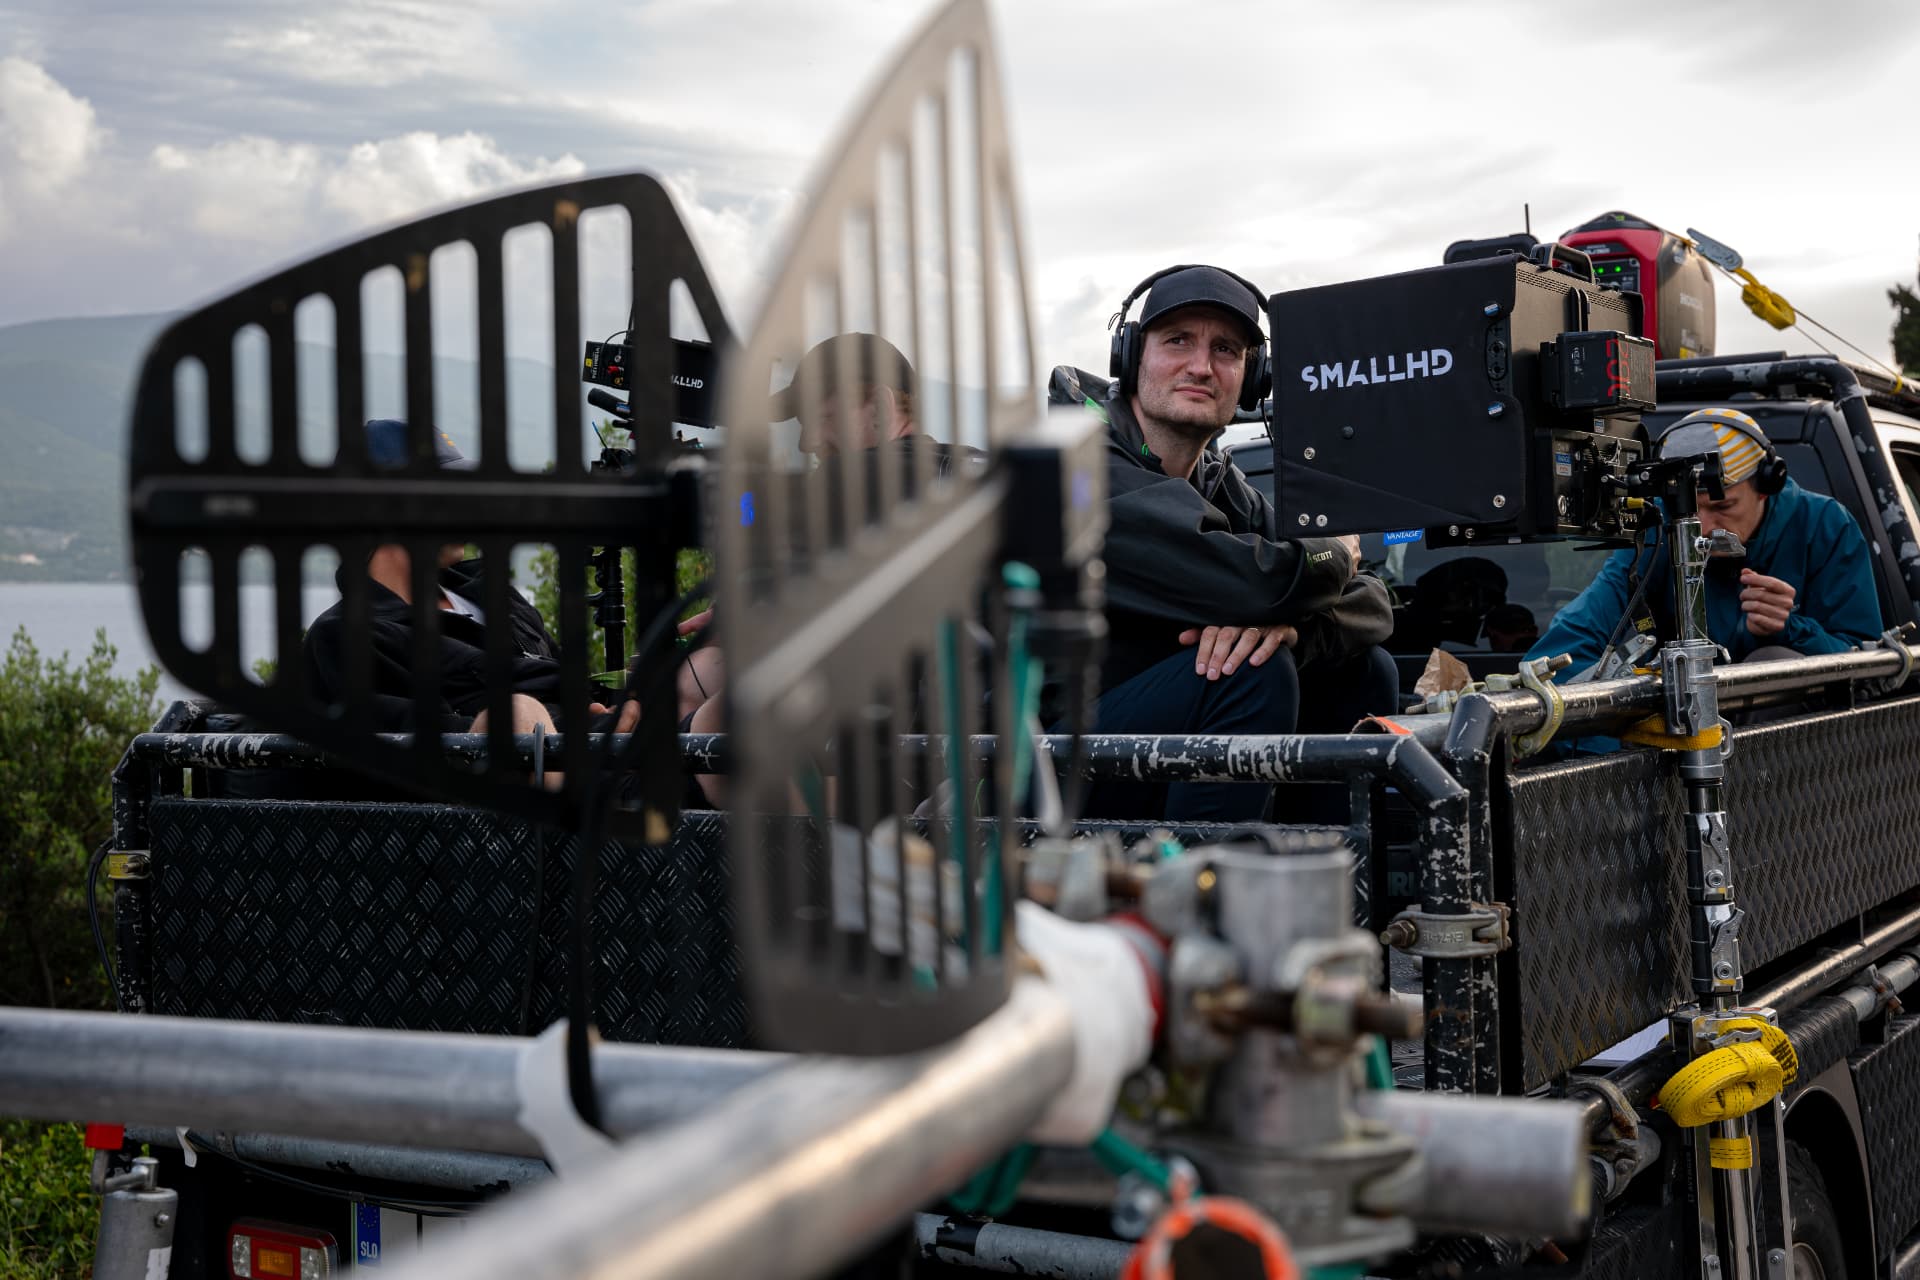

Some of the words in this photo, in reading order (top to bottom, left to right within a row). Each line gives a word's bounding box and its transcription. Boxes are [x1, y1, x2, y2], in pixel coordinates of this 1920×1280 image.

[1301, 349, 1453, 392] SMALLHD
[671, 375, 703, 389] ALLHD
[1386, 529, 1422, 541] VANTAGE
[1312, 550, 1333, 563] SCOTT
[360, 1240, 378, 1259] SLO
